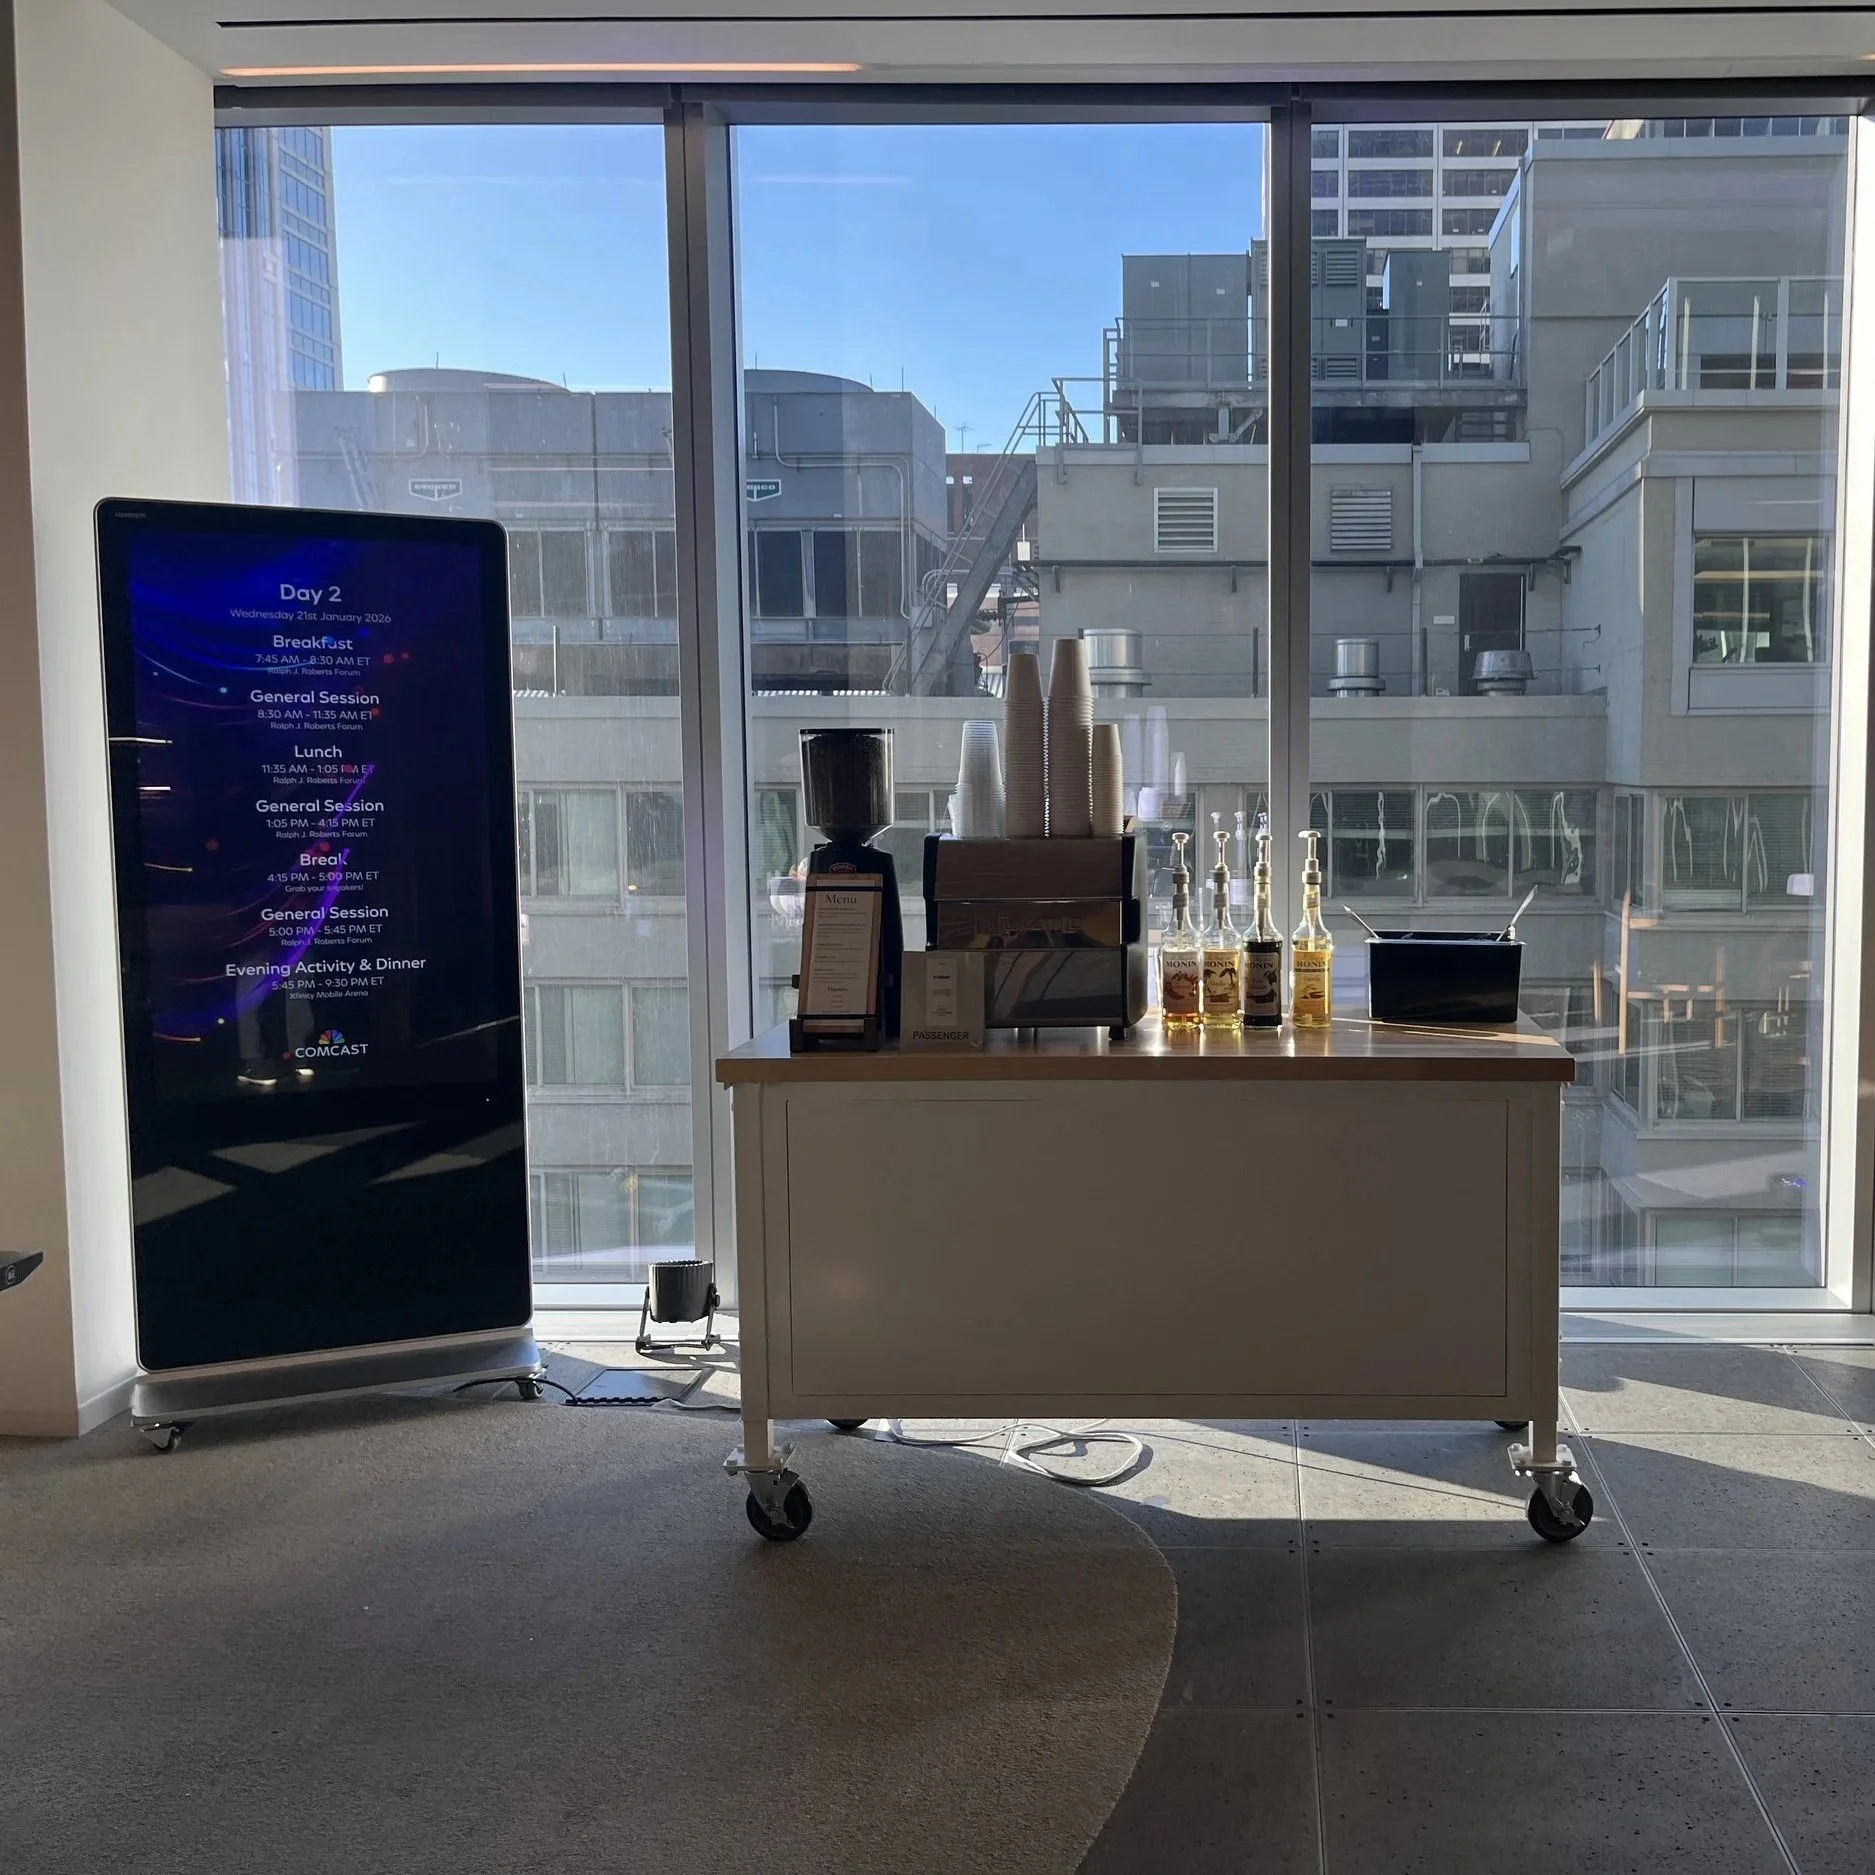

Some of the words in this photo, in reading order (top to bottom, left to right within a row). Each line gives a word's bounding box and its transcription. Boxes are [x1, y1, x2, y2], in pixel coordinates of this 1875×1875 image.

[280, 584, 322, 605] Day
[328, 586, 342, 602] 2
[230, 608, 294, 620] Wednesday
[296, 611, 317, 621] 21st
[320, 612, 362, 623] January
[365, 613, 391, 623] 2026
[273, 635, 353, 650] Breakfast
[256, 654, 278, 663] 7:45
[281, 655, 300, 664] AM
[310, 656, 333, 665] 8:30
[335, 657, 354, 665] AM
[358, 657, 371, 666] ET
[268, 668, 291, 676] Ralph
[302, 668, 332, 676] Roberts
[251, 690, 315, 703] General
[319, 691, 379, 704] Session
[258, 709, 281, 719] 8:30
[284, 710, 303, 719] AM
[313, 710, 336, 719] 11:35
[339, 711, 358, 719] AM
[361, 711, 373, 720] ET
[271, 722, 294, 730] Ralph
[294, 745, 342, 758] Lunch
[262, 765, 286, 773] 11:35
[289, 765, 307, 773] AM
[317, 765, 338, 773] 1:05
[256, 800, 319, 813] General
[324, 799, 384, 812] Session
[266, 819, 287, 828] 1:05
[290, 819, 308, 827] PM
[318, 819, 339, 827] 4:15
[342, 818, 359, 827] PM
[362, 818, 375, 827] ET
[276, 831, 299, 839] Ralph
[300, 853, 347, 866] Break
[267, 873, 288, 882] 4:15
[291, 873, 309, 881] PM
[319, 872, 342, 881] 5:00
[345, 872, 362, 880] PM
[366, 871, 379, 880] ET
[825, 894, 857, 904] Menu
[261, 907, 325, 921] General
[329, 906, 388, 919] Session
[269, 927, 293, 936] 5:00
[296, 926, 315, 936] PM
[324, 926, 346, 935] 5:45
[349, 925, 366, 934] PM
[369, 924, 382, 933] ET
[314, 937, 345, 945] Roberts
[226, 963, 291, 977] Evening
[295, 960, 355, 974] Activity
[360, 959, 371, 971] &
[377, 958, 426, 970] Dinner
[1166, 960, 1197, 968] MONIN
[1203, 960, 1234, 968] MONIN
[271, 980, 294, 991] 5:45
[298, 979, 315, 989] PM
[325, 978, 348, 988] 9:30
[351, 978, 368, 987] PM
[371, 977, 384, 986] ET
[290, 992, 314, 1000] Xfinity
[317, 991, 343, 999] Mobile
[345, 989, 368, 997] Arena
[913, 1031, 969, 1040] PASSENGER
[295, 1044, 368, 1059] COMCAST
